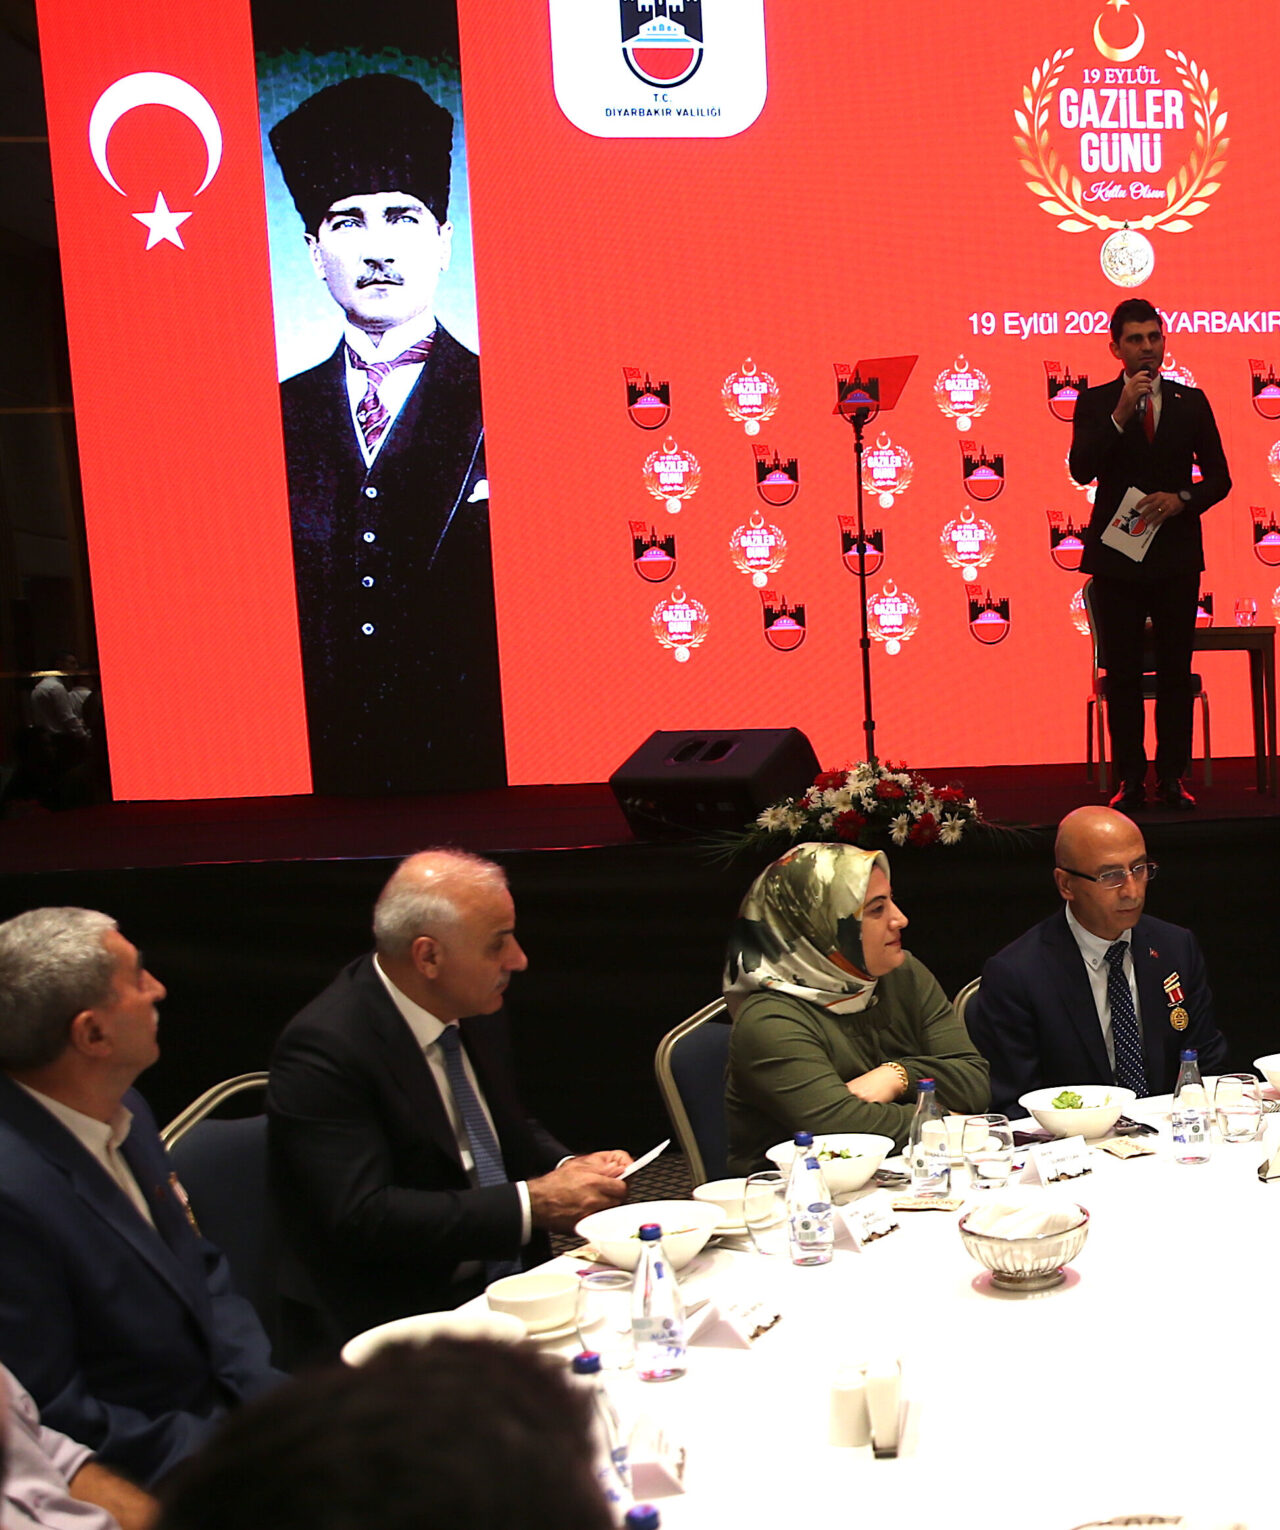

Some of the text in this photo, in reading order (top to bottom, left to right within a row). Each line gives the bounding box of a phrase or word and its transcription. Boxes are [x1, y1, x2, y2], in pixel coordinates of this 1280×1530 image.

[1082, 65, 1161, 84] 19 EYLÜL
[1060, 87, 1185, 130] GAZİLER
[1080, 131, 1162, 174] GÜNÜ
[968, 311, 996, 335] 19
[1002, 311, 1058, 340] Eylül
[1064, 311, 1111, 335] 202
